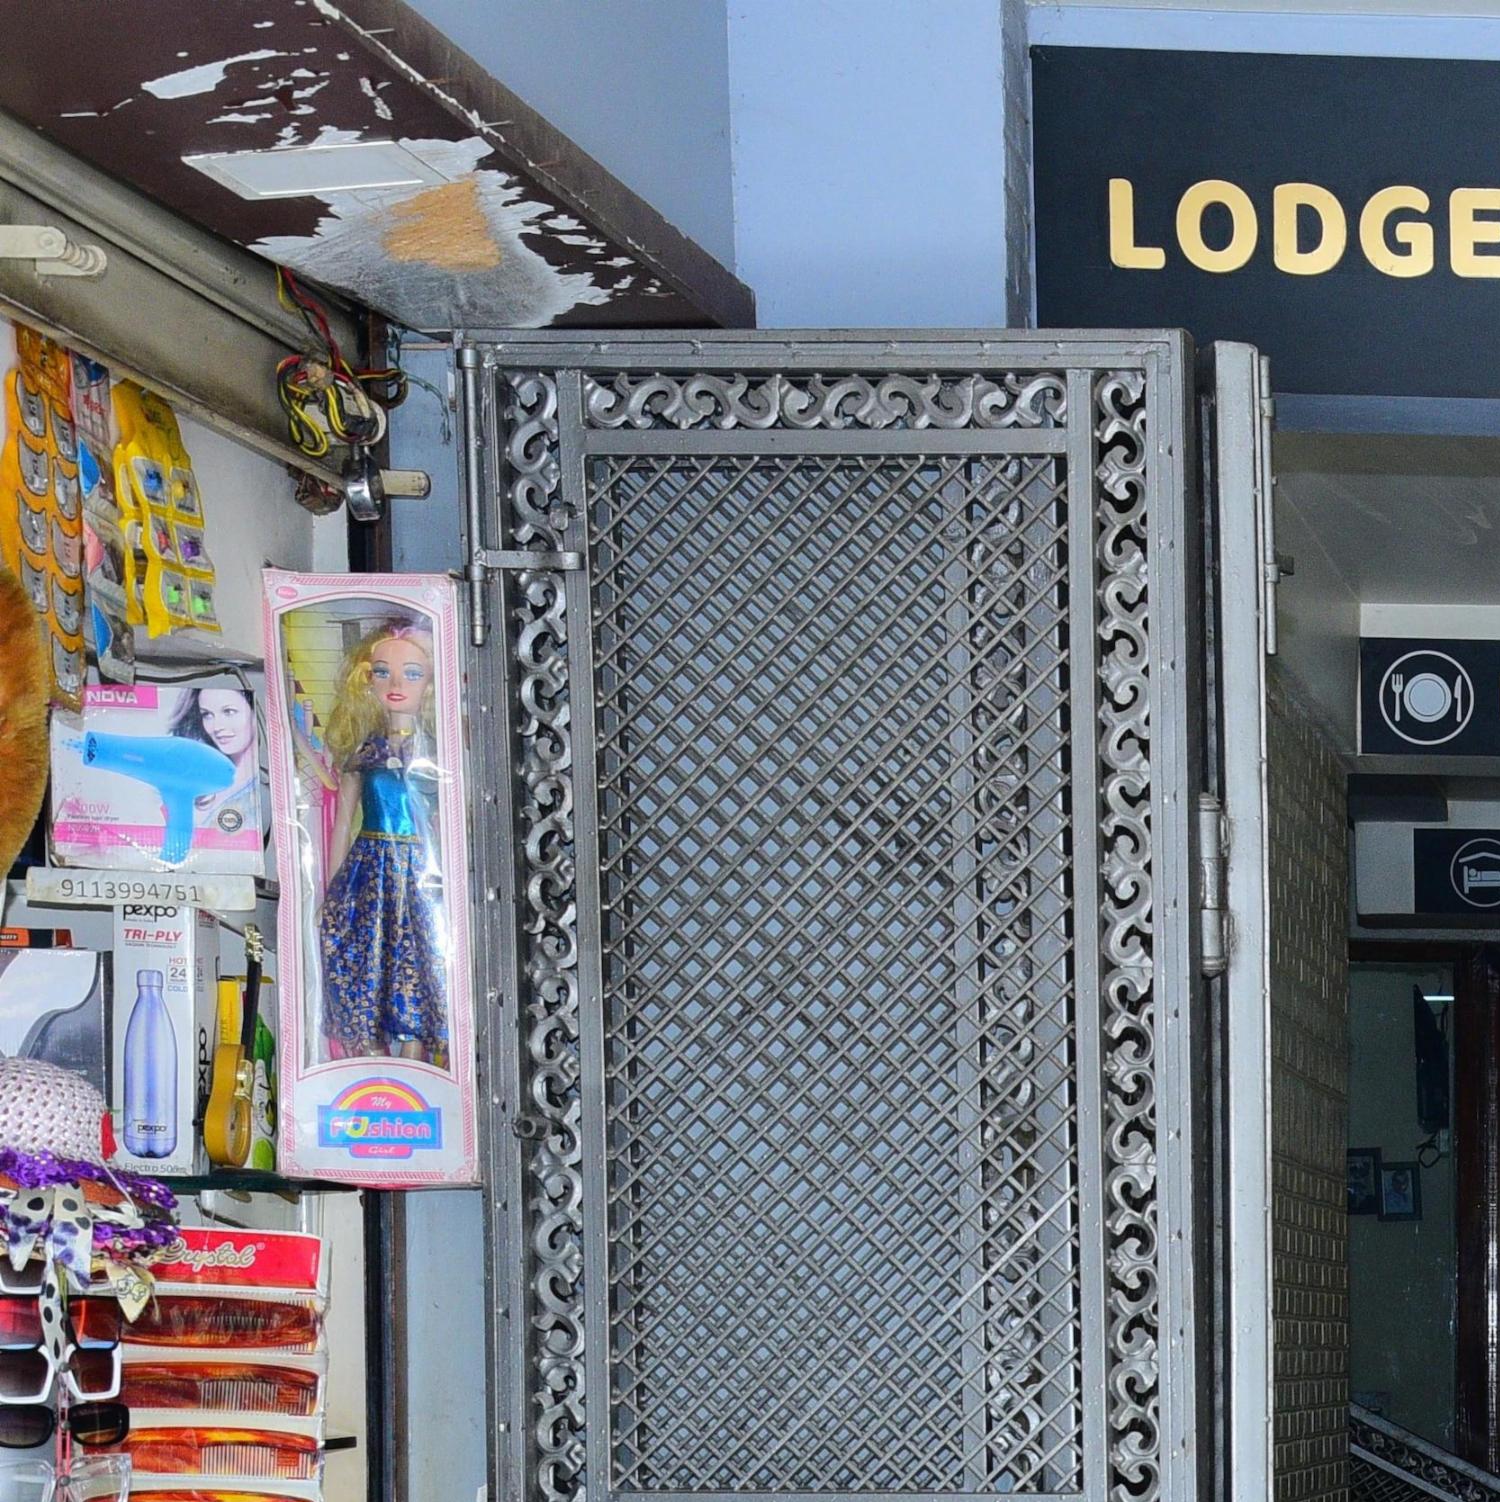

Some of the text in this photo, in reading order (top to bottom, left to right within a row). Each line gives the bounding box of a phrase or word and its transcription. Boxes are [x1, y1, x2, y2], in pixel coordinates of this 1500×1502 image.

[86, 690, 138, 704] NOVA
[60, 879, 201, 902] 9113994751
[123, 904, 178, 923] pexpo
[123, 929, 184, 943] TRI-PLY
[370, 1096, 392, 1109] My
[330, 1116, 432, 1139] Fashion
